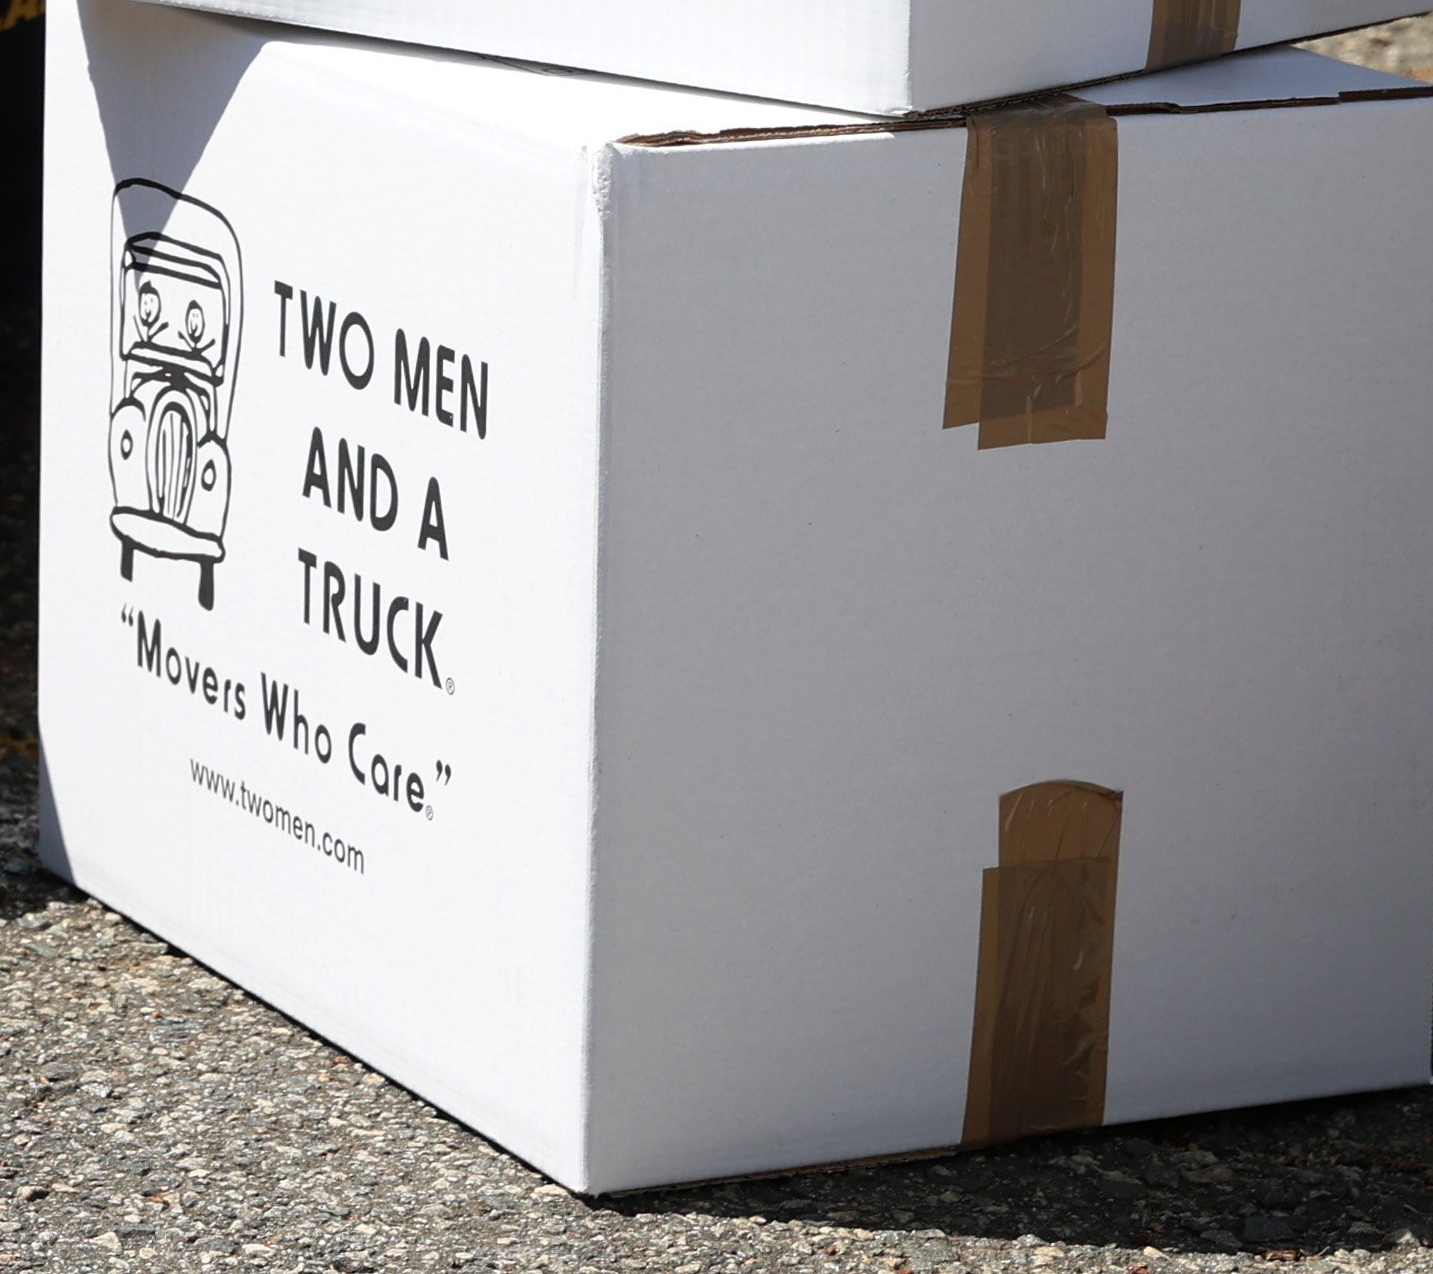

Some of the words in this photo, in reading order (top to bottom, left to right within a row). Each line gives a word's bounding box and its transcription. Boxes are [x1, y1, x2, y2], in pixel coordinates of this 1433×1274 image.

[274, 280, 374, 390] TWO
[394, 328, 488, 440] MEN
[302, 427, 398, 531] AND
[418, 477, 449, 561] A
[261, 672, 332, 764] Who
[190, 759, 364, 874] www.twomen.com
